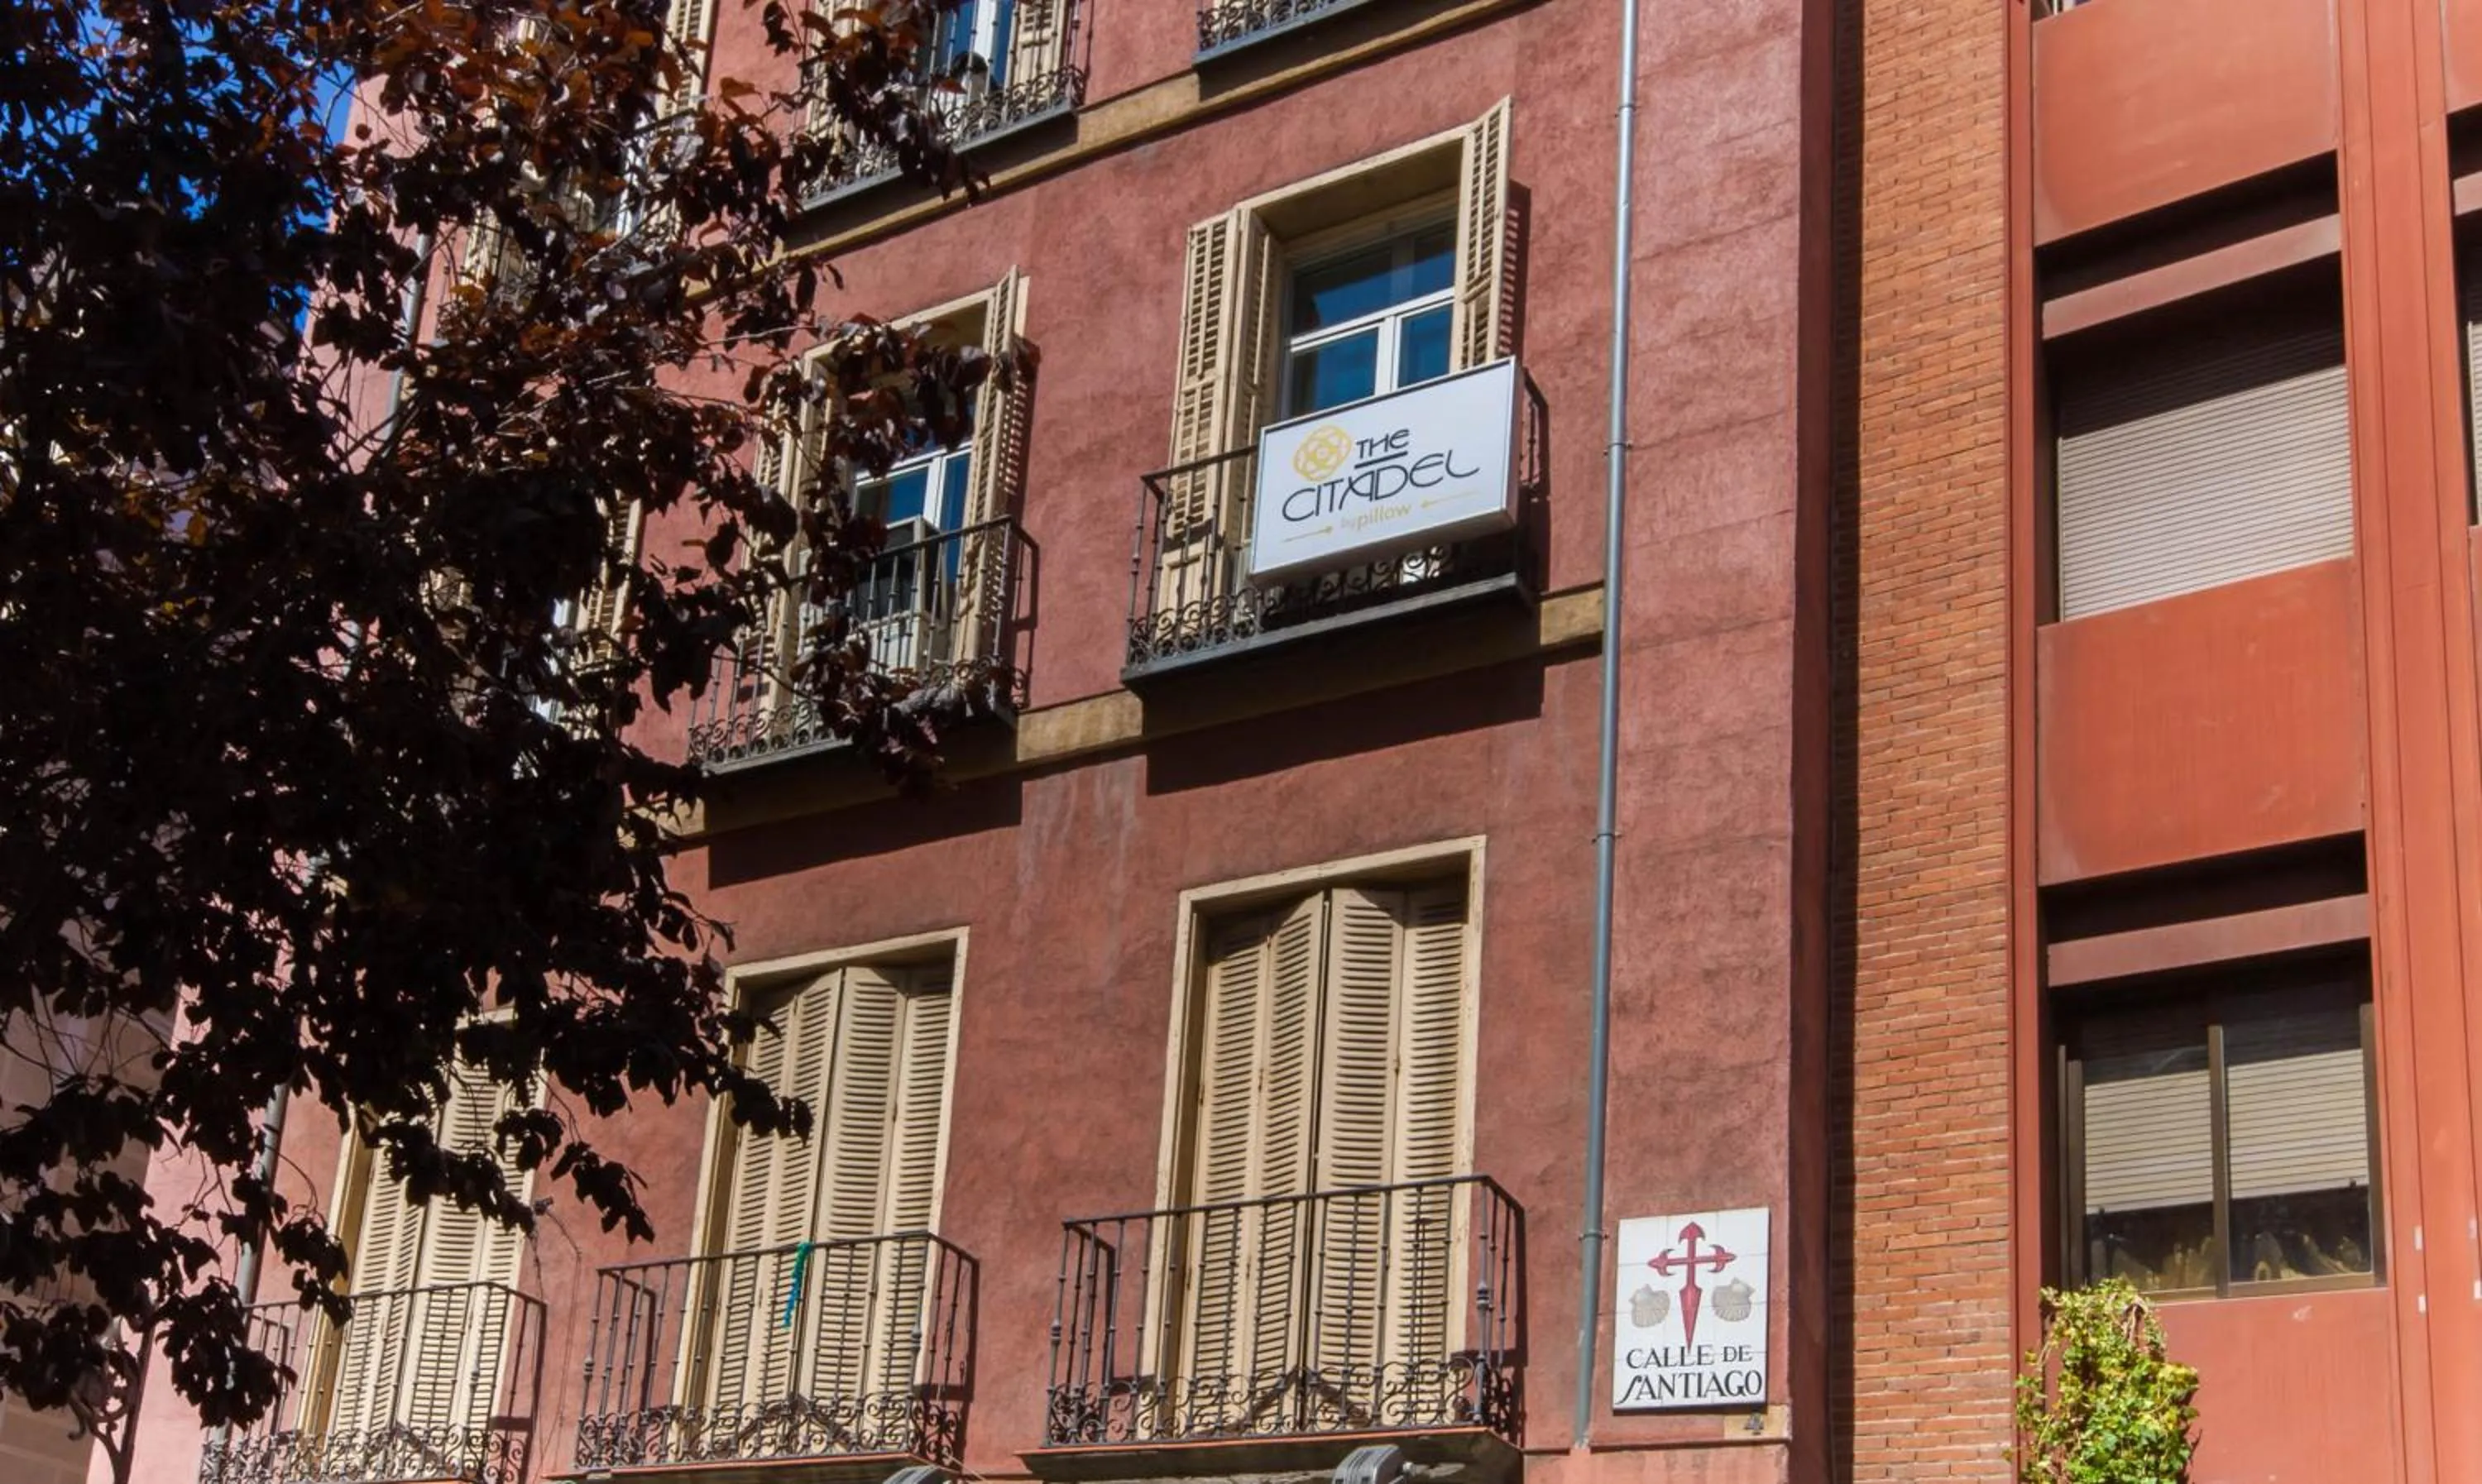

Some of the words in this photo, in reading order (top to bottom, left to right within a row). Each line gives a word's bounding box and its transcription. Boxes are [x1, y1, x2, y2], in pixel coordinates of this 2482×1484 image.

[1355, 428, 1410, 458] THE
[1282, 449, 1480, 522] CITADEL
[1626, 1344, 1715, 1369] CALLE
[1723, 1345, 1753, 1363] DE
[1614, 1370, 1762, 1405] SANTIAGO
